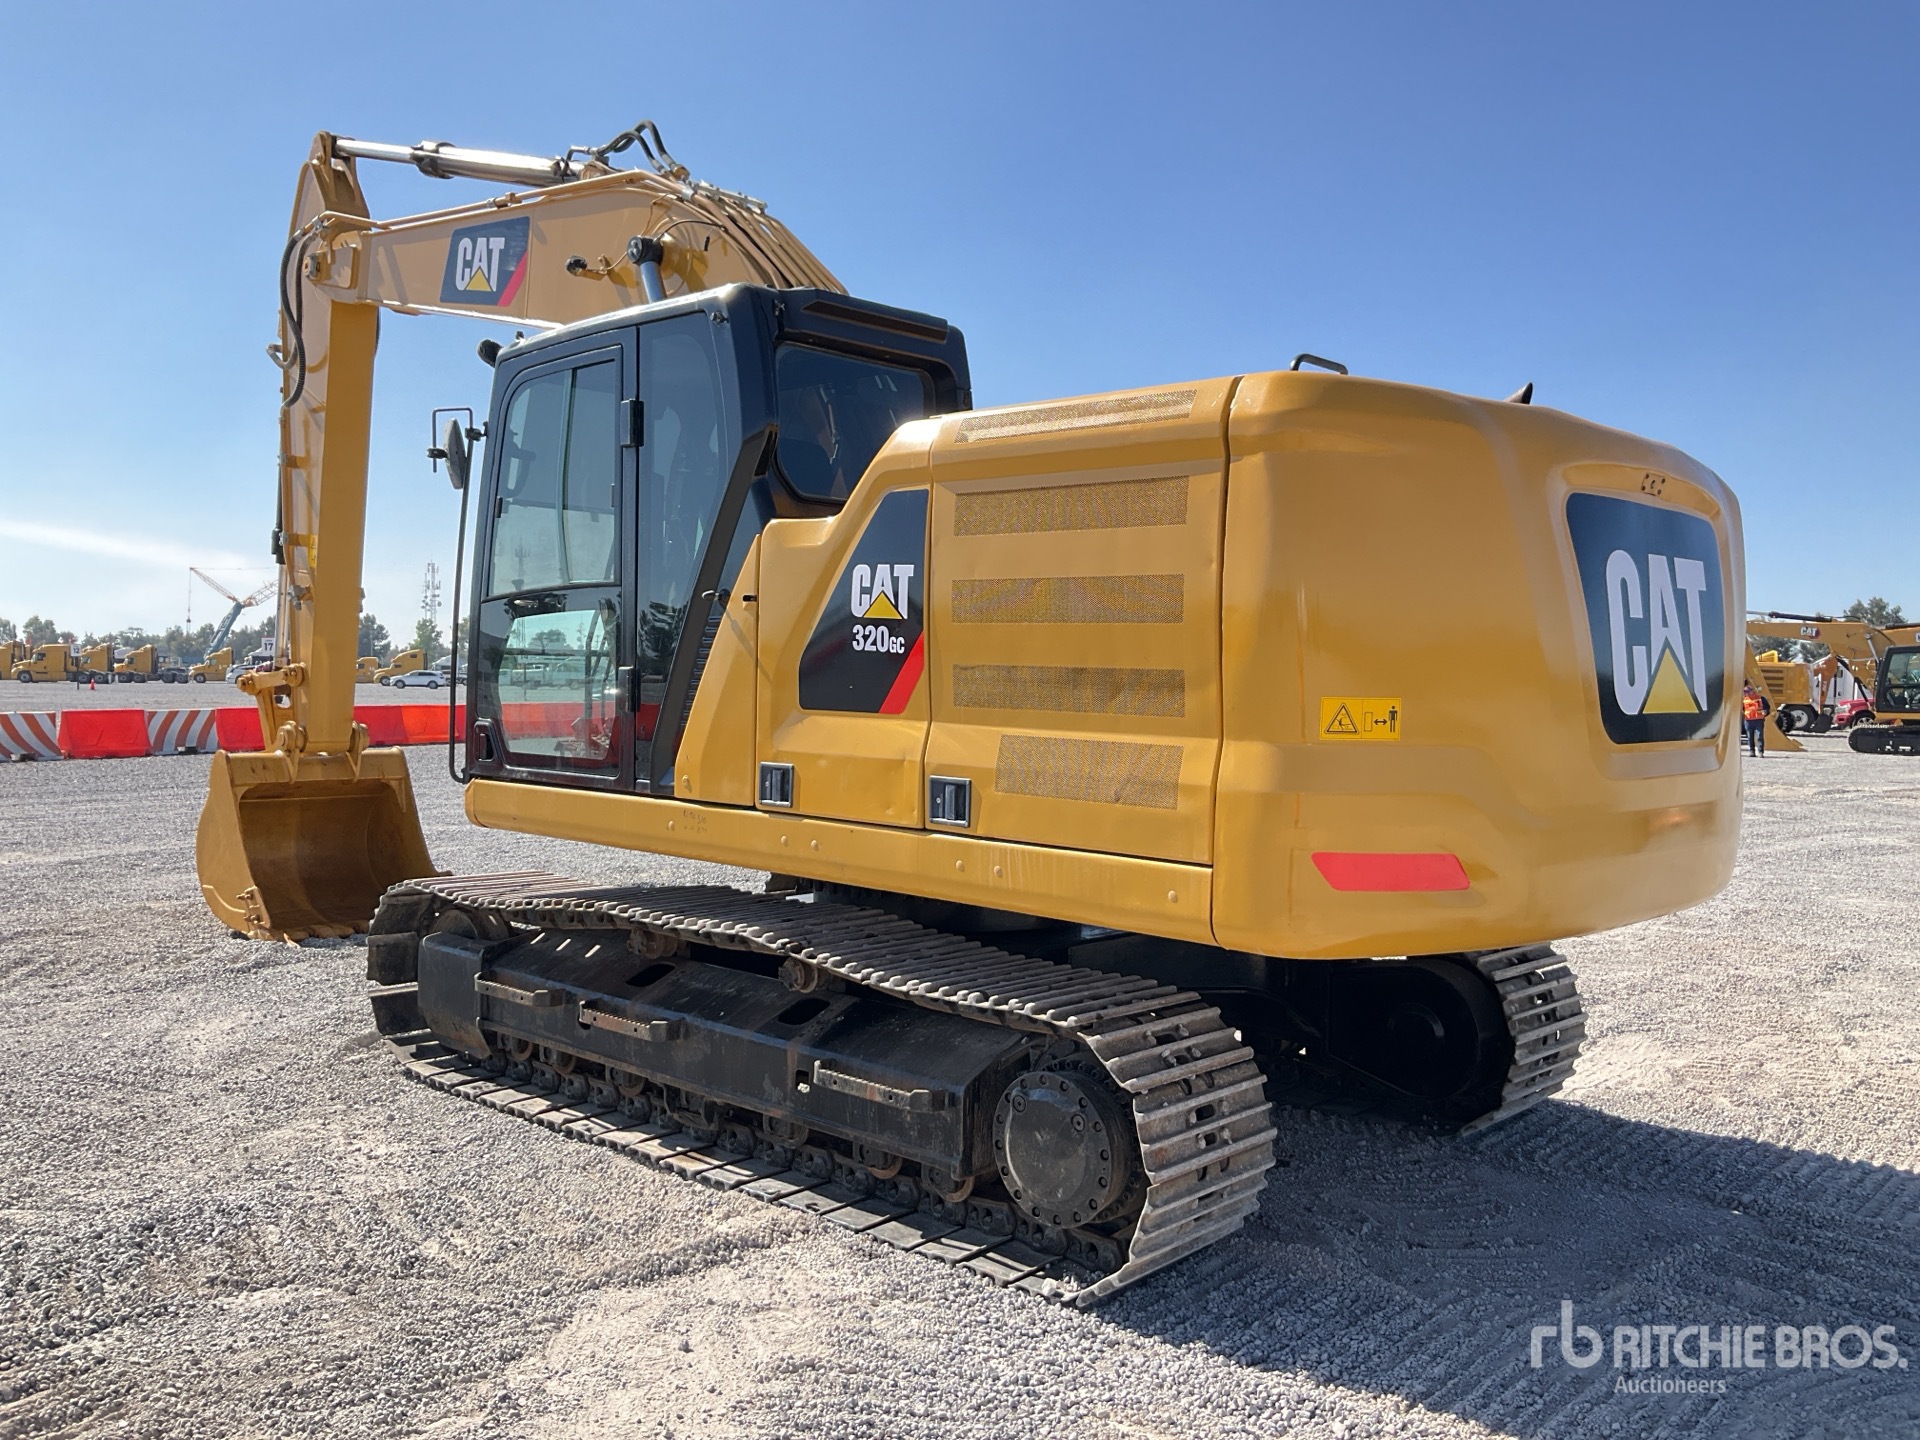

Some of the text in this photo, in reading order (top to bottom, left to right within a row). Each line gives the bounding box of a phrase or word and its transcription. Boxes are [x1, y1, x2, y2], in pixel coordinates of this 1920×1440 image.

[455, 237, 505, 292] CAT
[851, 564, 914, 620] CAT
[264, 642, 274, 651] 17
[1606, 549, 1707, 716] CAT
[1800, 626, 1818, 637] CAT
